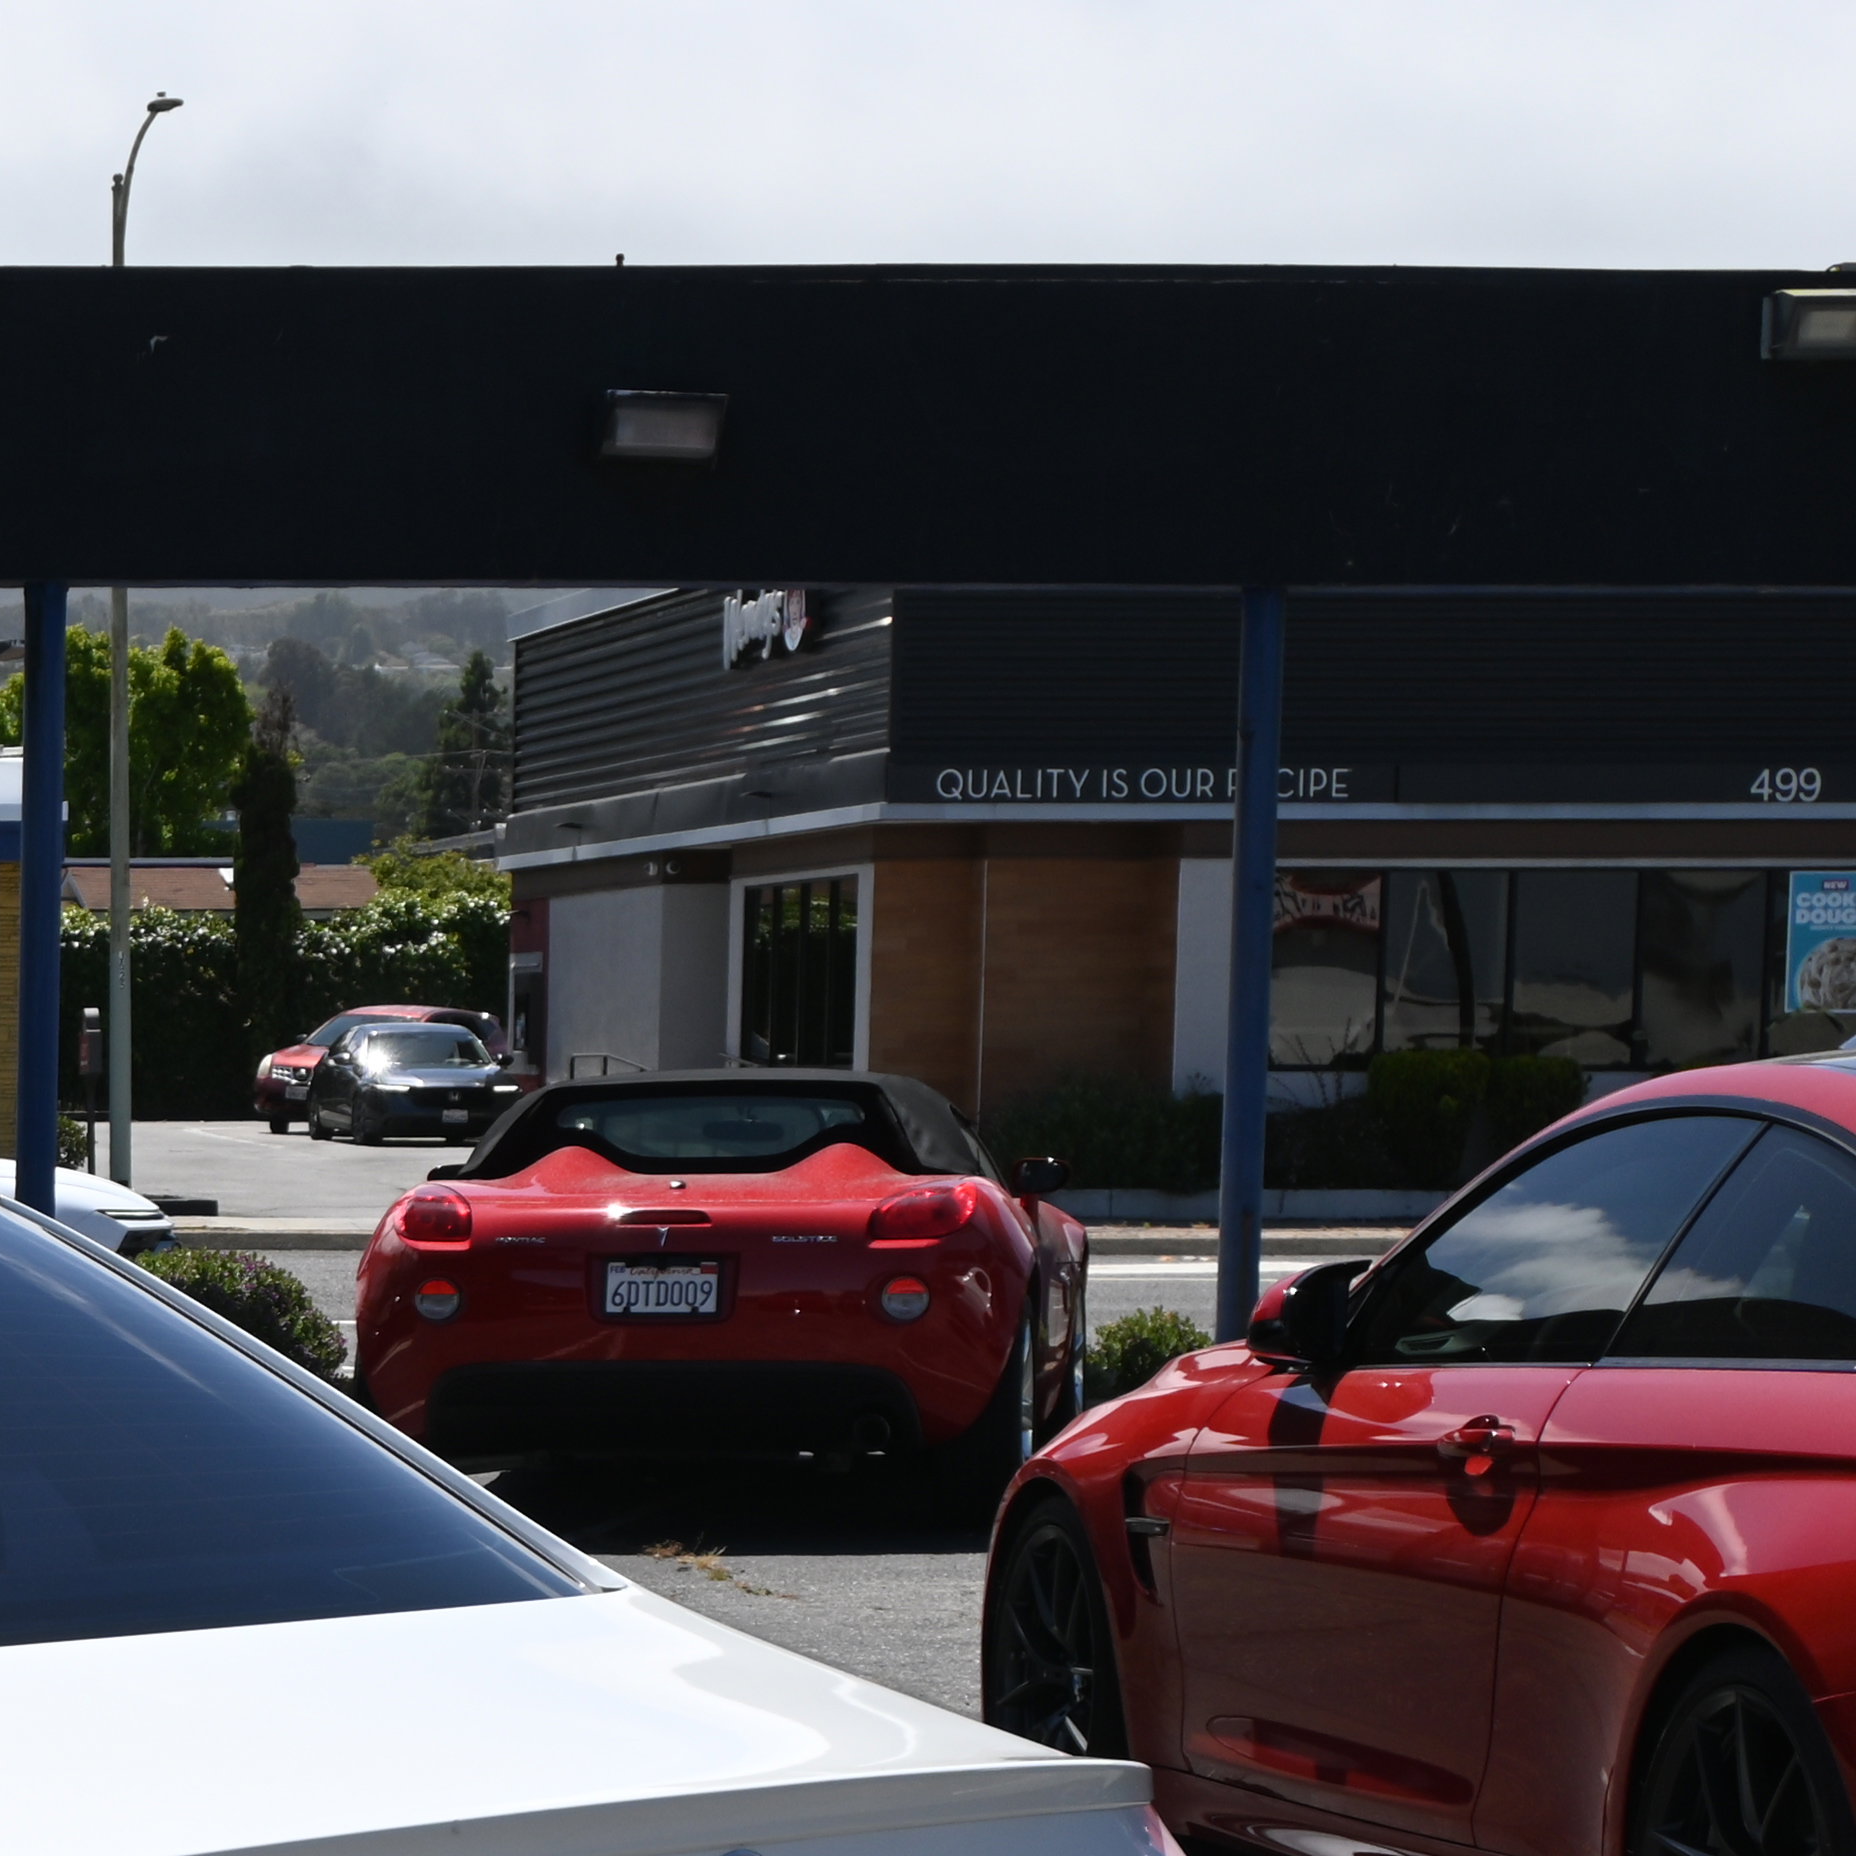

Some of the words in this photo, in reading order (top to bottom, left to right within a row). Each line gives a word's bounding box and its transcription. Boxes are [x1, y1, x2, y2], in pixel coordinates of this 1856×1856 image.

[936, 768, 1090, 801] QUALITY
[1102, 768, 1129, 799] IS
[1140, 768, 1215, 799] OUR
[1750, 767, 1822, 802] 499
[611, 1280, 713, 1307] 6DTD009
